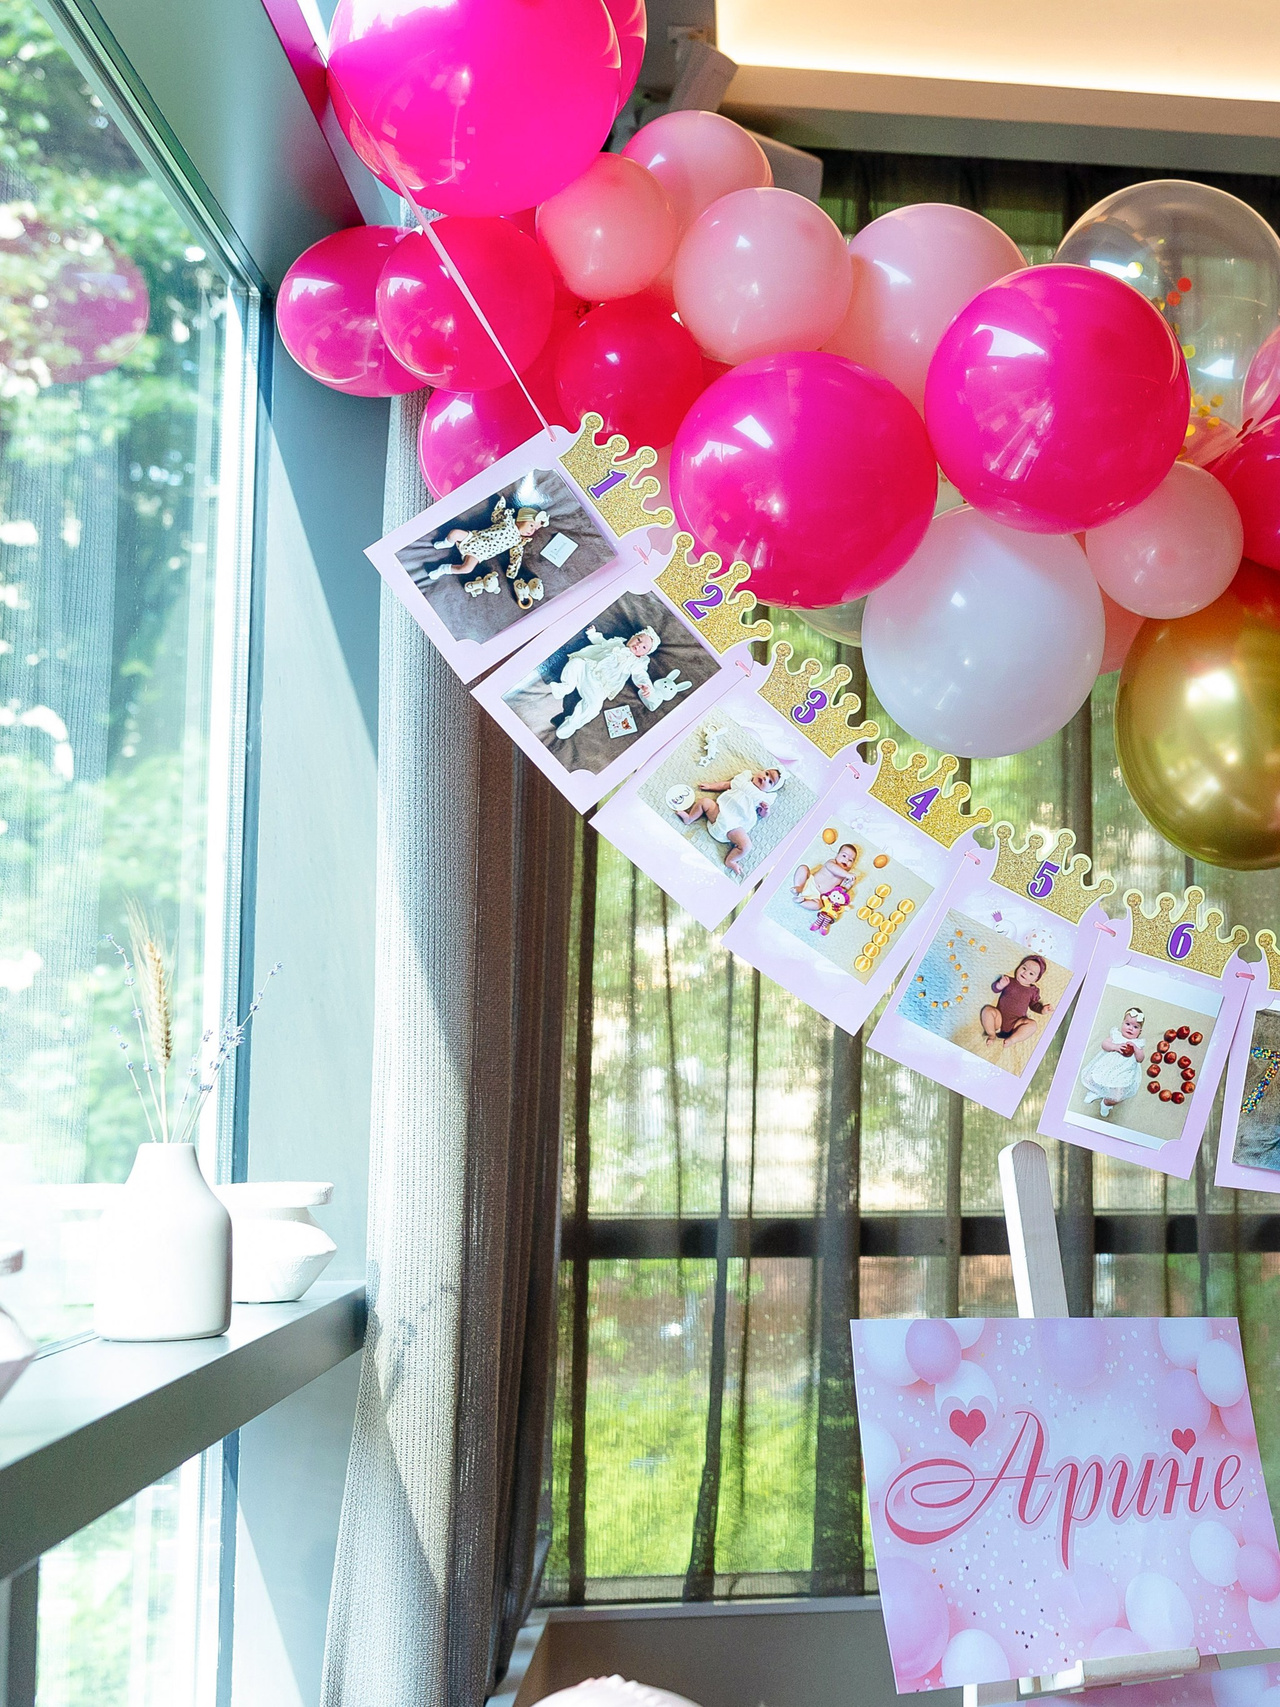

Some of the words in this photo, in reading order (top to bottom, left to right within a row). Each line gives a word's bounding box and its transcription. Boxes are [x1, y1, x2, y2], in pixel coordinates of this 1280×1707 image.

[589, 469, 628, 500] 1
[684, 583, 724, 621] 2
[793, 689, 828, 725] 3
[908, 786, 941, 822] 4
[1028, 860, 1061, 899] 5
[1168, 922, 1196, 960] 6
[1146, 1025, 1203, 1104] 6
[884, 1410, 1243, 1570] Арине
